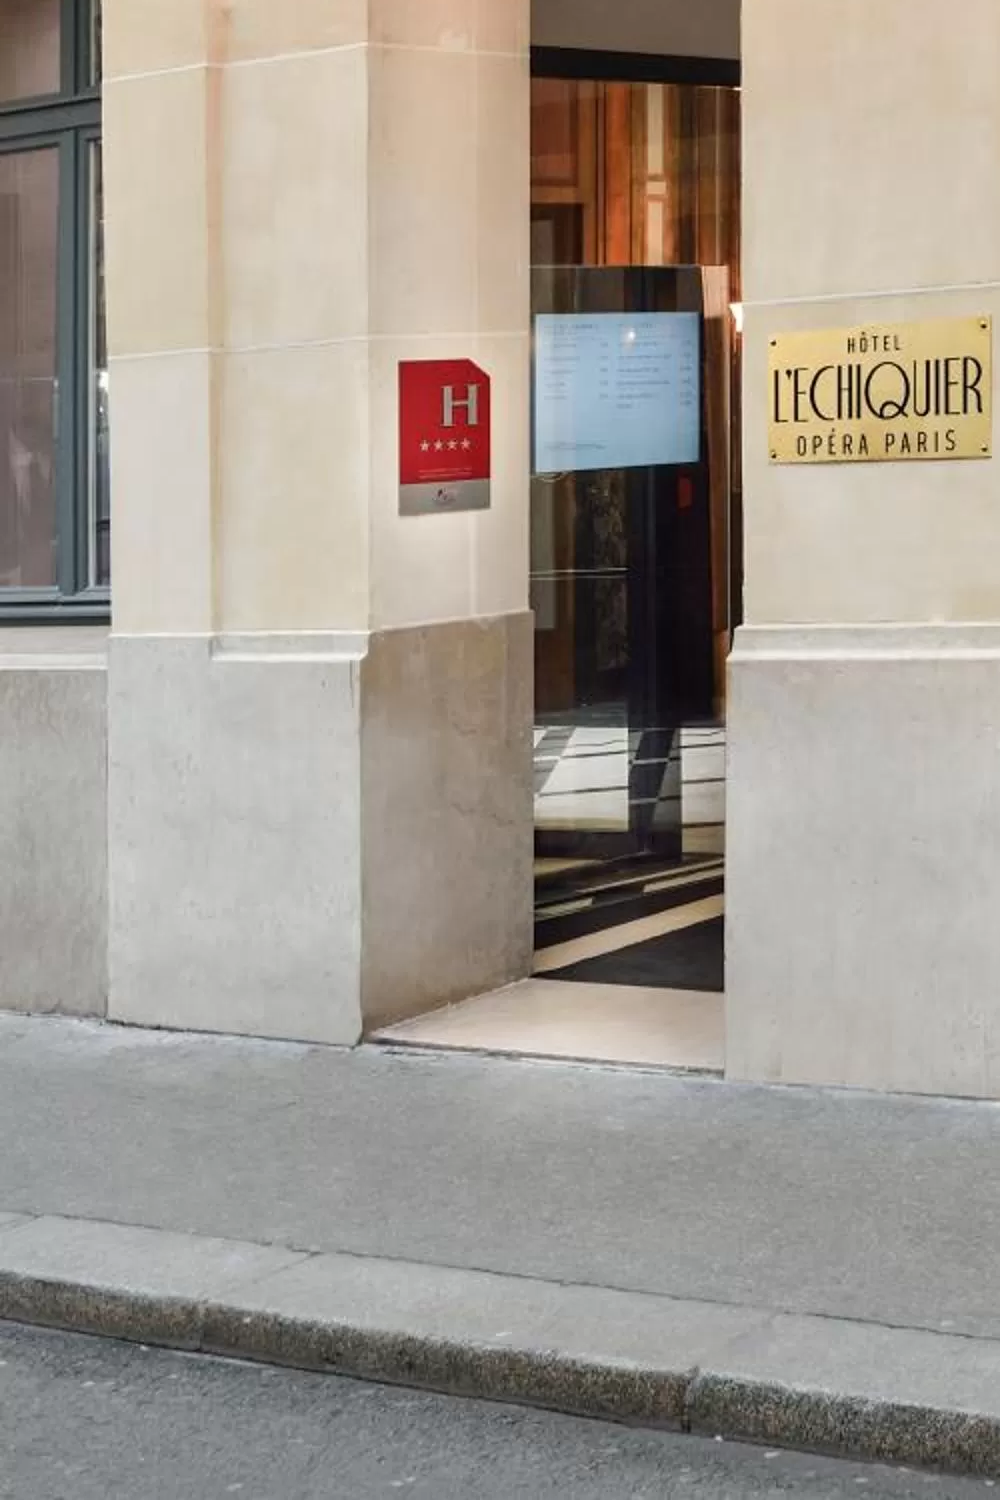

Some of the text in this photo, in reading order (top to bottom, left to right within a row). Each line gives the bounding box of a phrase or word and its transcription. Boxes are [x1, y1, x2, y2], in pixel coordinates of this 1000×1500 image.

[847, 332, 902, 353] HÔTEL
[441, 384, 479, 426] H
[773, 356, 983, 423] L'ECHIQUIER
[796, 429, 956, 457] OPÉRA PARIS
